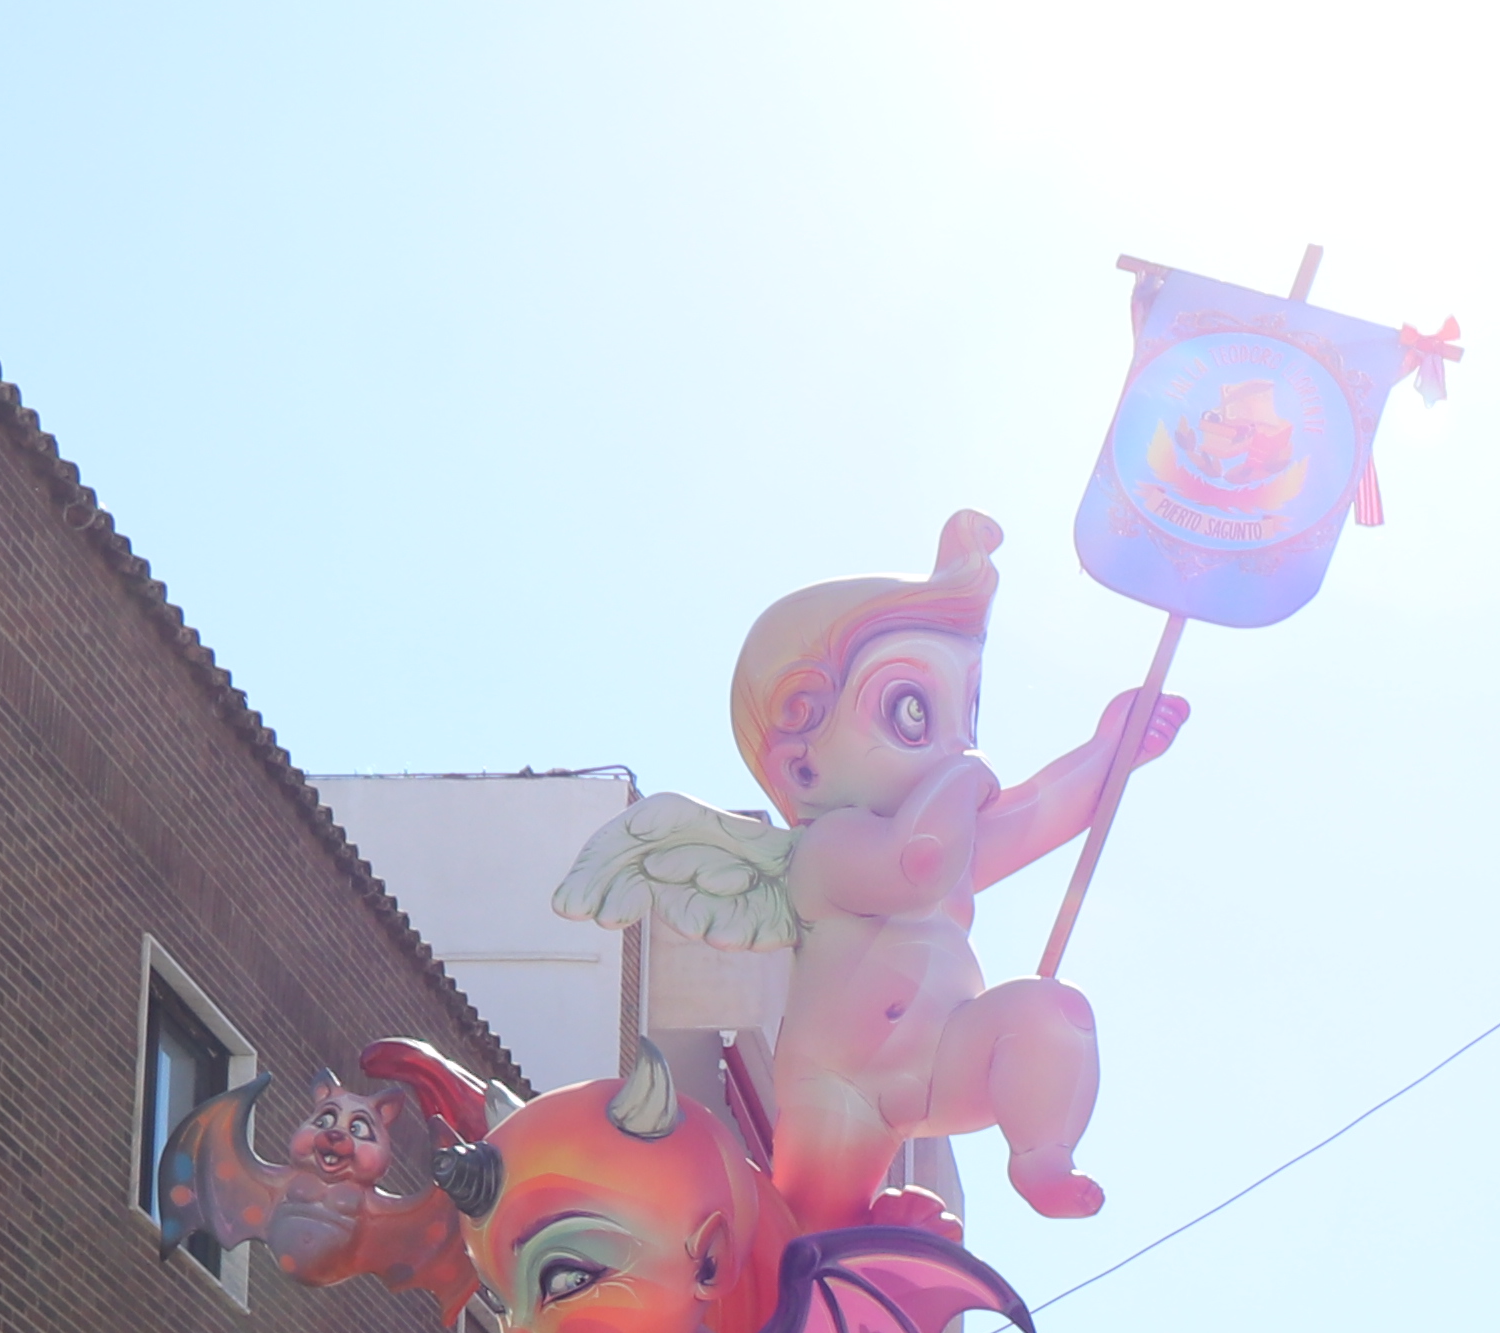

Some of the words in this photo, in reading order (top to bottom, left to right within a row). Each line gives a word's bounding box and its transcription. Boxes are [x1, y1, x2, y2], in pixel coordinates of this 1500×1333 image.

[1208, 344, 1284, 370] TEODORO
[1155, 498, 1203, 531] PUERTO
[1204, 517, 1263, 541] SAGUNTO
